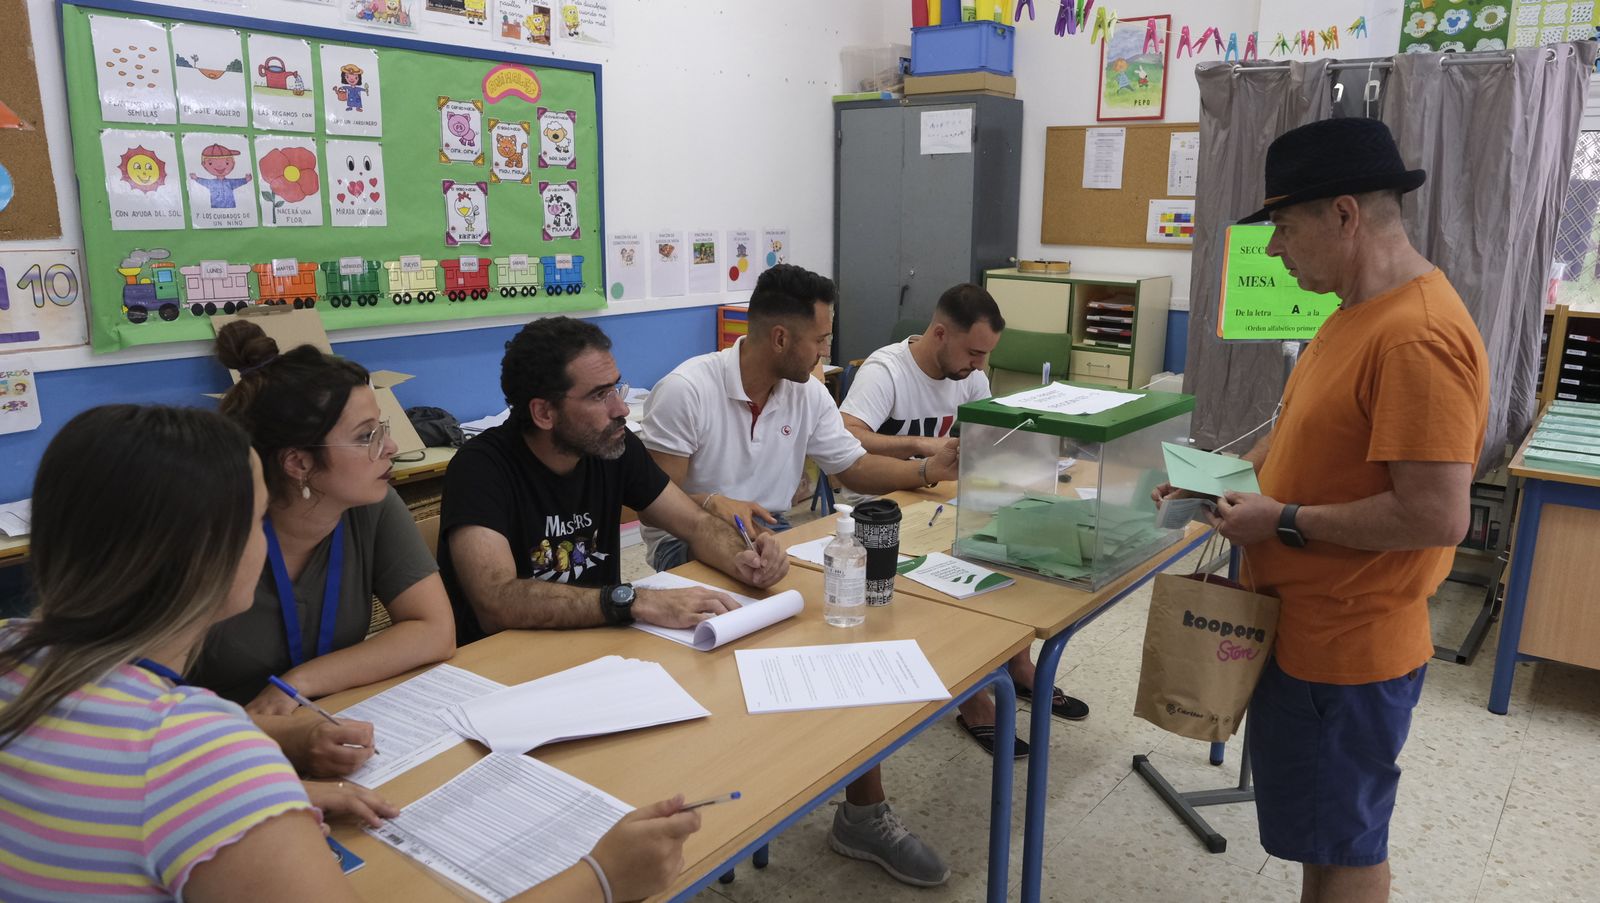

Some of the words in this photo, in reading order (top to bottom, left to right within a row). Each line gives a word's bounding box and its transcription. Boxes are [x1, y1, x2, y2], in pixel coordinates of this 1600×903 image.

[127, 109, 158, 118] SEMILLAS
[214, 109, 241, 117] AGUJERO
[114, 209, 129, 218] CON
[131, 209, 153, 217] AYUDA
[335, 208, 355, 216] MIRADA
[285, 216, 303, 224] FLOR
[276, 264, 295, 272] MARTES
[17, 263, 79, 309] 10
[1238, 275, 1276, 288] MESA
[1235, 308, 1244, 316] De
[1246, 308, 1254, 316] la
[1254, 308, 1272, 316] letra
[1291, 304, 1300, 314] A
[1313, 308, 1320, 316] la
[1182, 609, 1266, 643] koopera
[1216, 639, 1261, 662] Store
